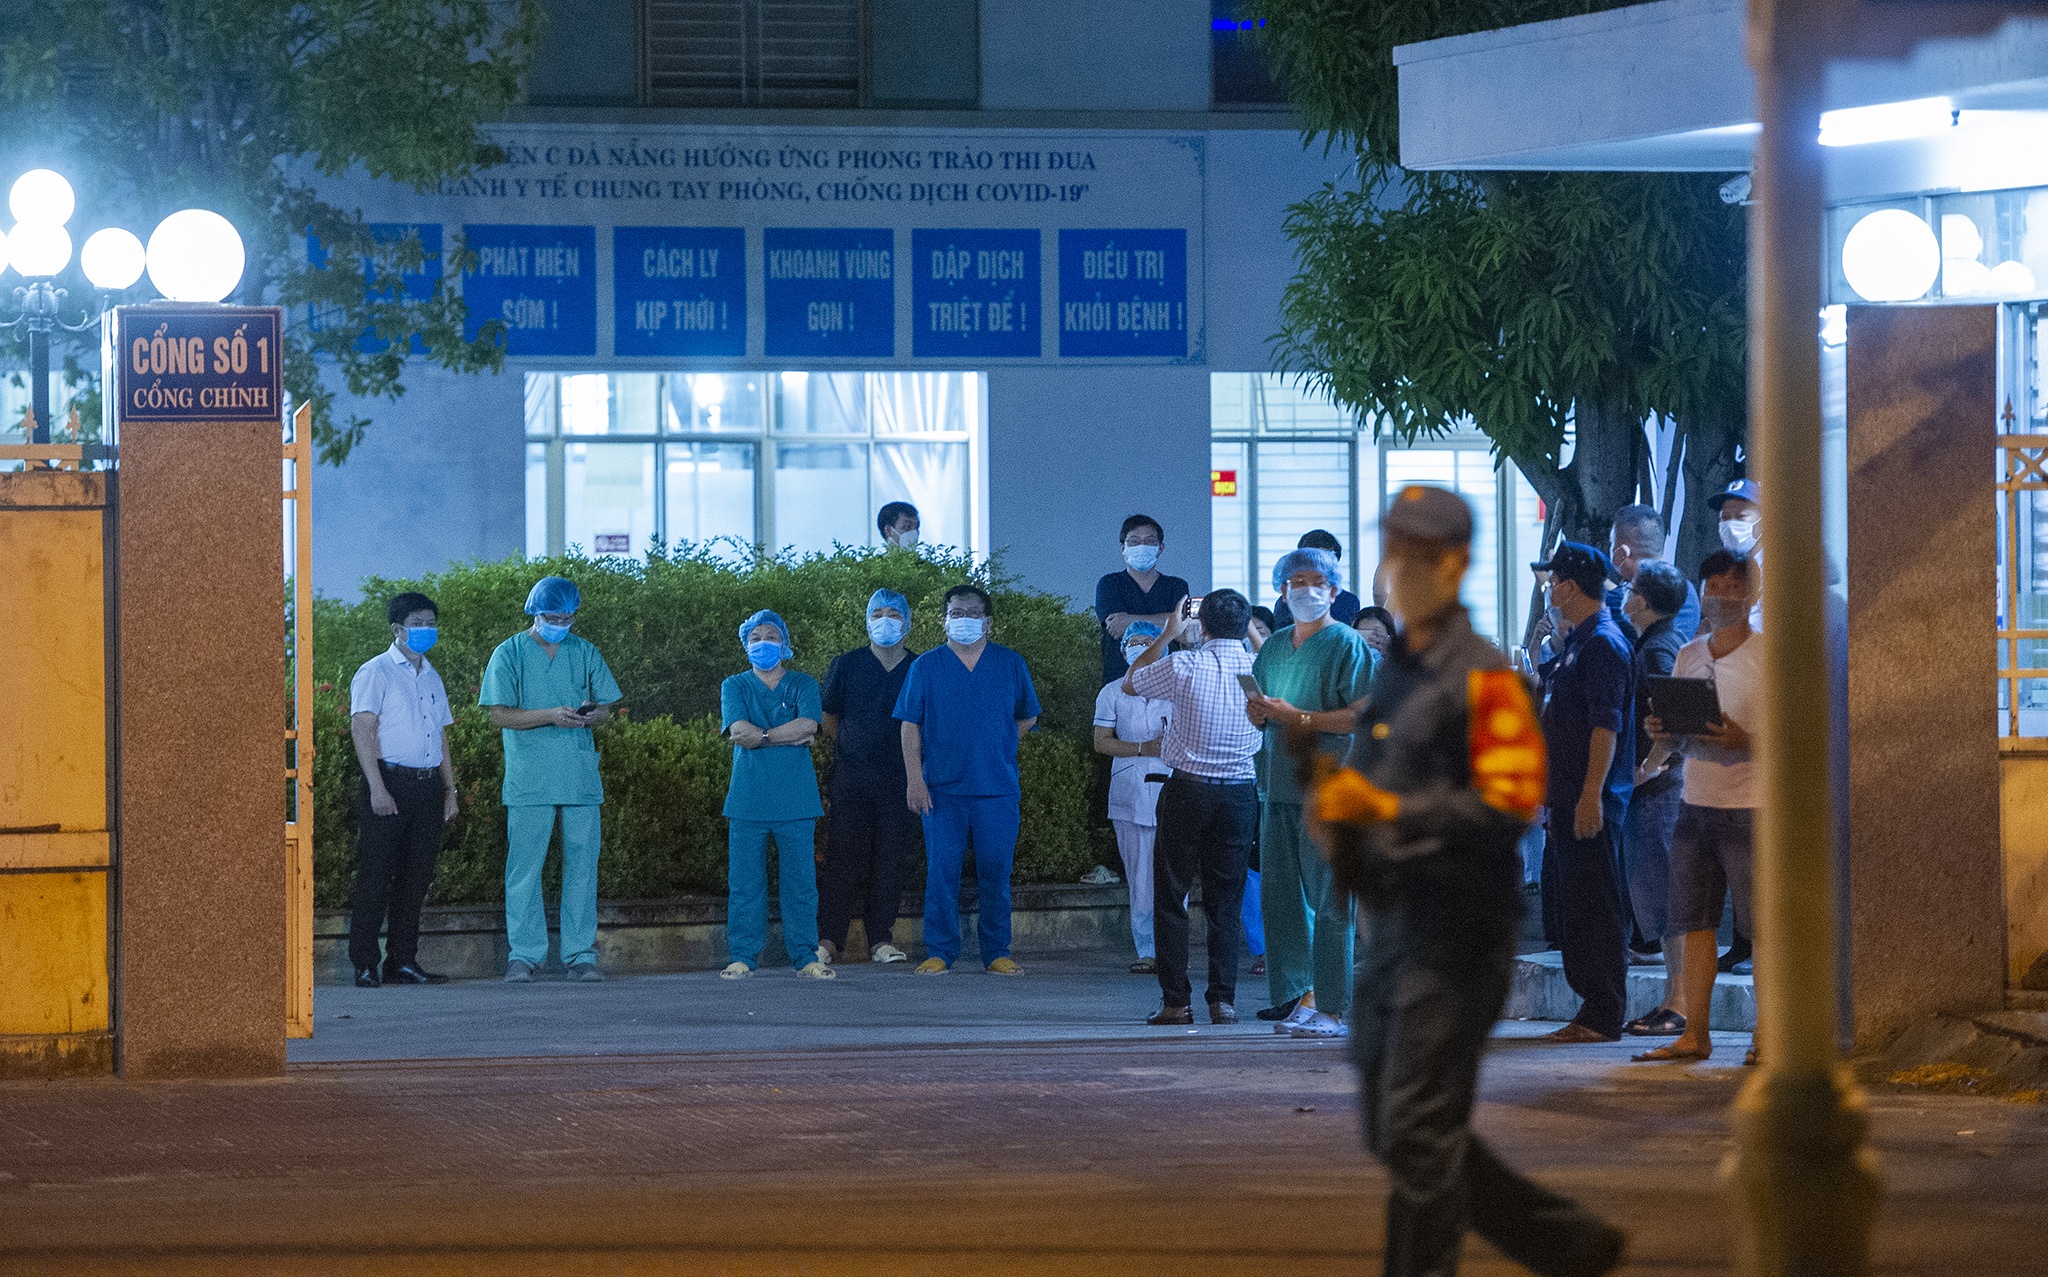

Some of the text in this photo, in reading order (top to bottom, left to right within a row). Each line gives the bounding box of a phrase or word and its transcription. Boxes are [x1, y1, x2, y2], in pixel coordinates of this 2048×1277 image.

[545, 146, 561, 167] C
[609, 138, 676, 168] NẴNG
[684, 141, 770, 168] HƯỞNG
[779, 144, 829, 169] ỨNG
[837, 149, 922, 170] PHONG
[928, 146, 993, 170] TRÀO
[1000, 151, 1040, 170] THI
[1048, 151, 1097, 170] ĐUA
[514, 178, 529, 198] Y
[536, 172, 569, 198] TẾ
[574, 179, 661, 200] CHUNG
[667, 181, 710, 200] TAY
[719, 176, 810, 204] PHÒNG,
[816, 174, 902, 202] CHỐNG
[909, 182, 969, 207] DỊCH
[535, 242, 579, 284] HIỆN
[643, 243, 718, 278] CÁCH LY
[769, 244, 892, 279] KHOANH VÙNG
[932, 244, 1024, 286] DẬP DỊCH
[1083, 242, 1164, 286] ĐIỀU TRỊ
[636, 301, 667, 336] KỊP
[673, 294, 715, 330] THỜI
[808, 302, 842, 337] GỌN
[929, 295, 982, 338] TRIỆT
[1065, 292, 1111, 331] KHỎI
[1118, 295, 1170, 338] BỆNH
[132, 322, 269, 375] CỔNG SỐ 1
[133, 378, 269, 409] CỔNG CHÍNH
